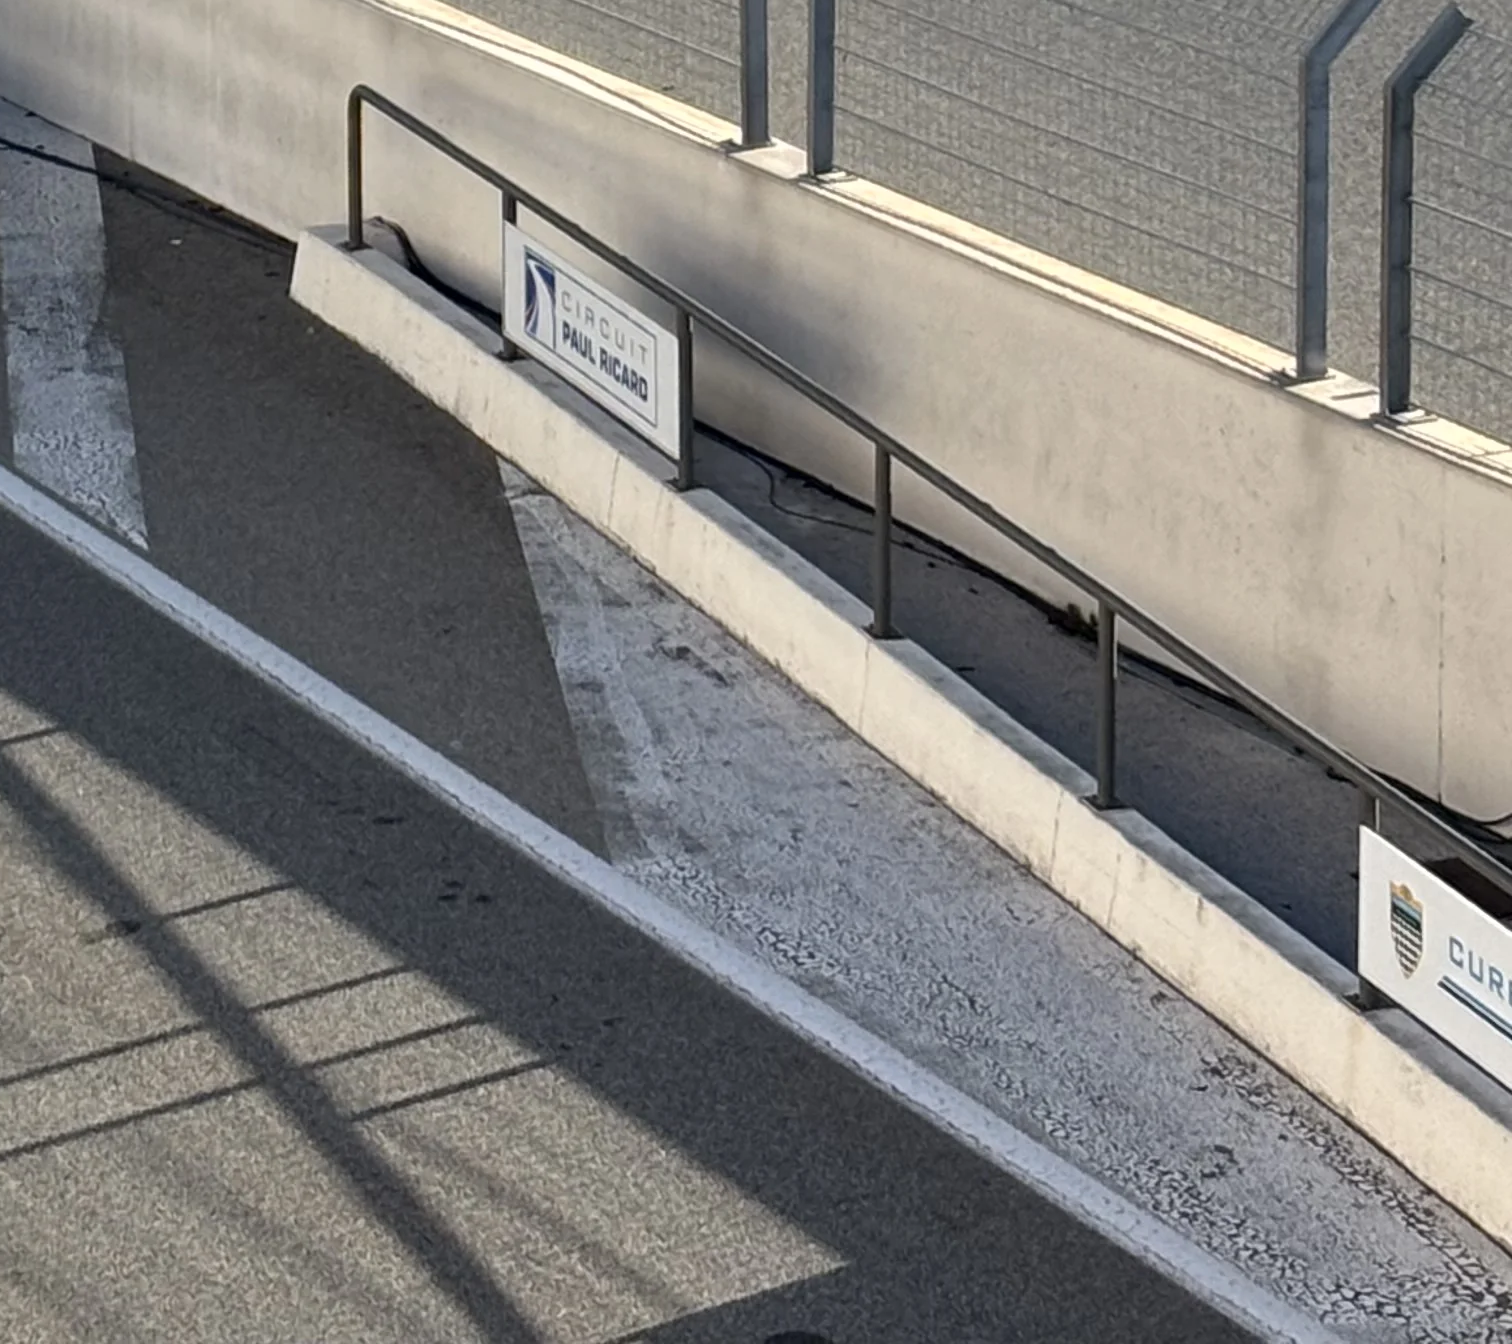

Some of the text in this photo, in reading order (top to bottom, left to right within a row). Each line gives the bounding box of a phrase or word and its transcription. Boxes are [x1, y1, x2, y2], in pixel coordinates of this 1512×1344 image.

[562, 291, 648, 365] CIRCUIT
[563, 321, 648, 402] PAUL RICARD
